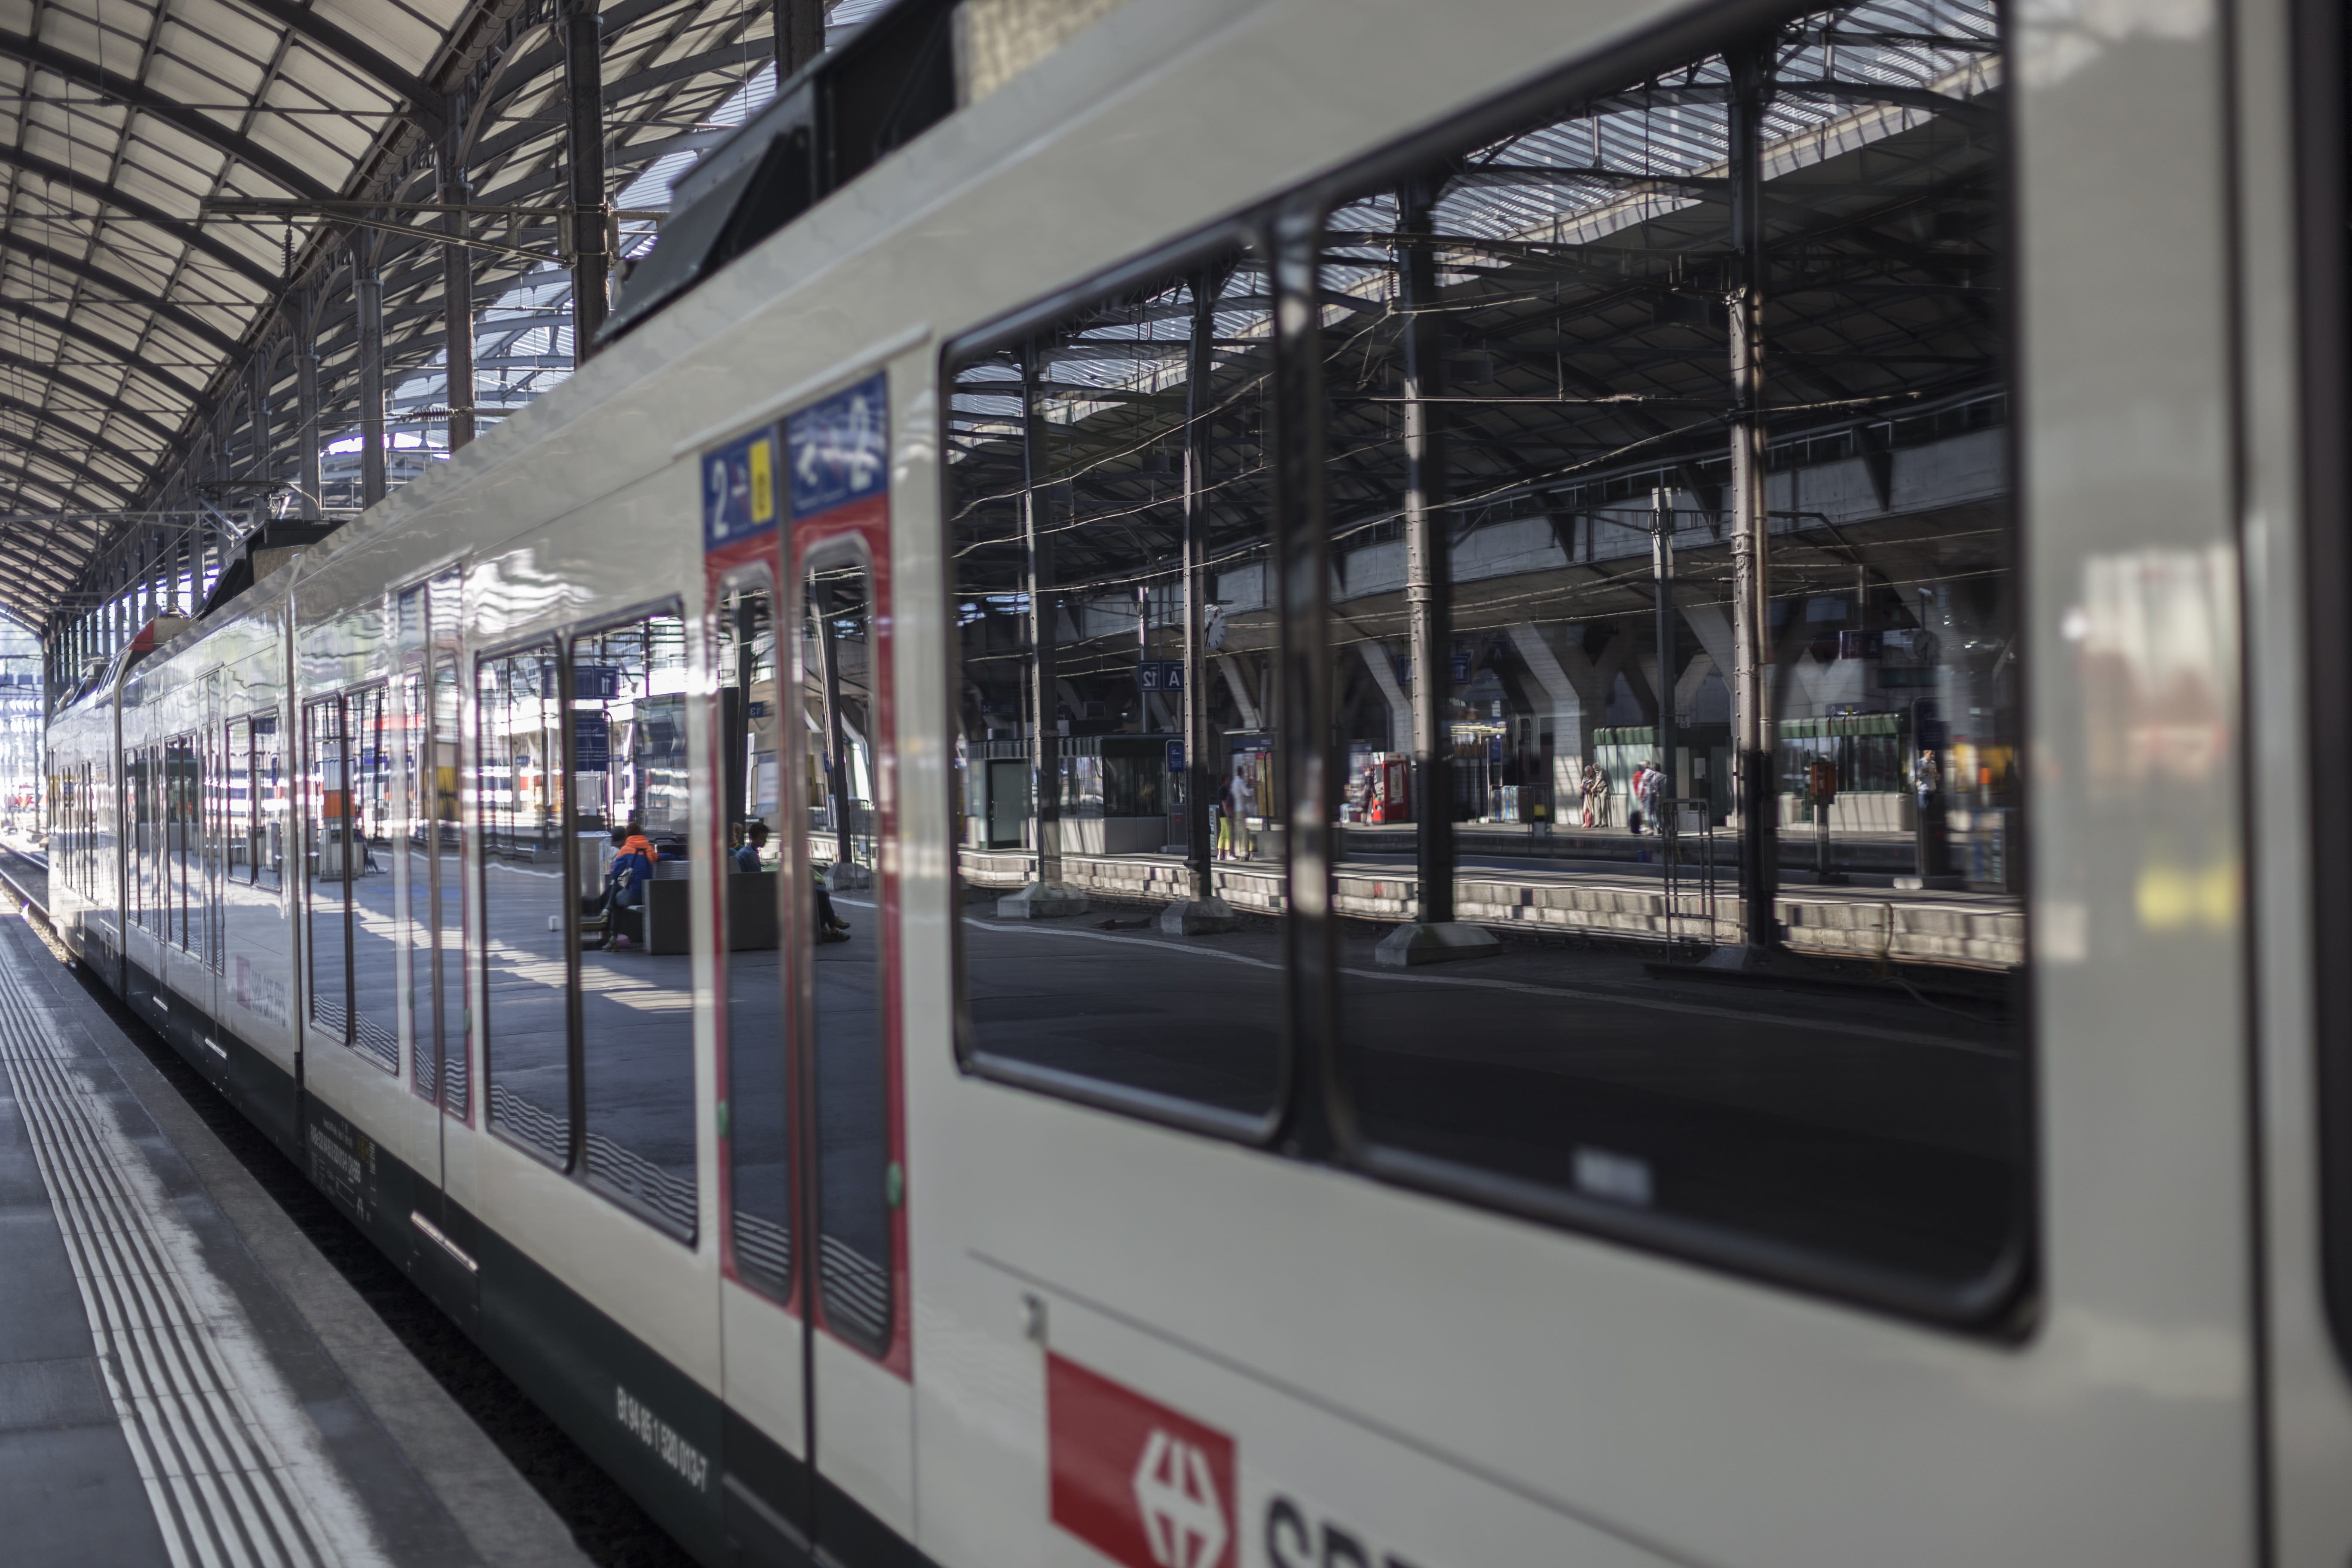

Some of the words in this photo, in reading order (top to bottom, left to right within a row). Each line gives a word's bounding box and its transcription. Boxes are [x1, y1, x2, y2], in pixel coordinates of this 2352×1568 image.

[710, 459, 730, 540] 2
[251, 969, 262, 1013] SBB
[263, 975, 273, 1020] CFF
[274, 980, 286, 1029] FFS
[617, 1386, 627, 1425] Bt
[628, 1397, 639, 1435] 94
[641, 1408, 651, 1446] 85
[653, 1418, 658, 1452] 1
[661, 1424, 678, 1470] 520
[680, 1440, 707, 1493] 013-7
